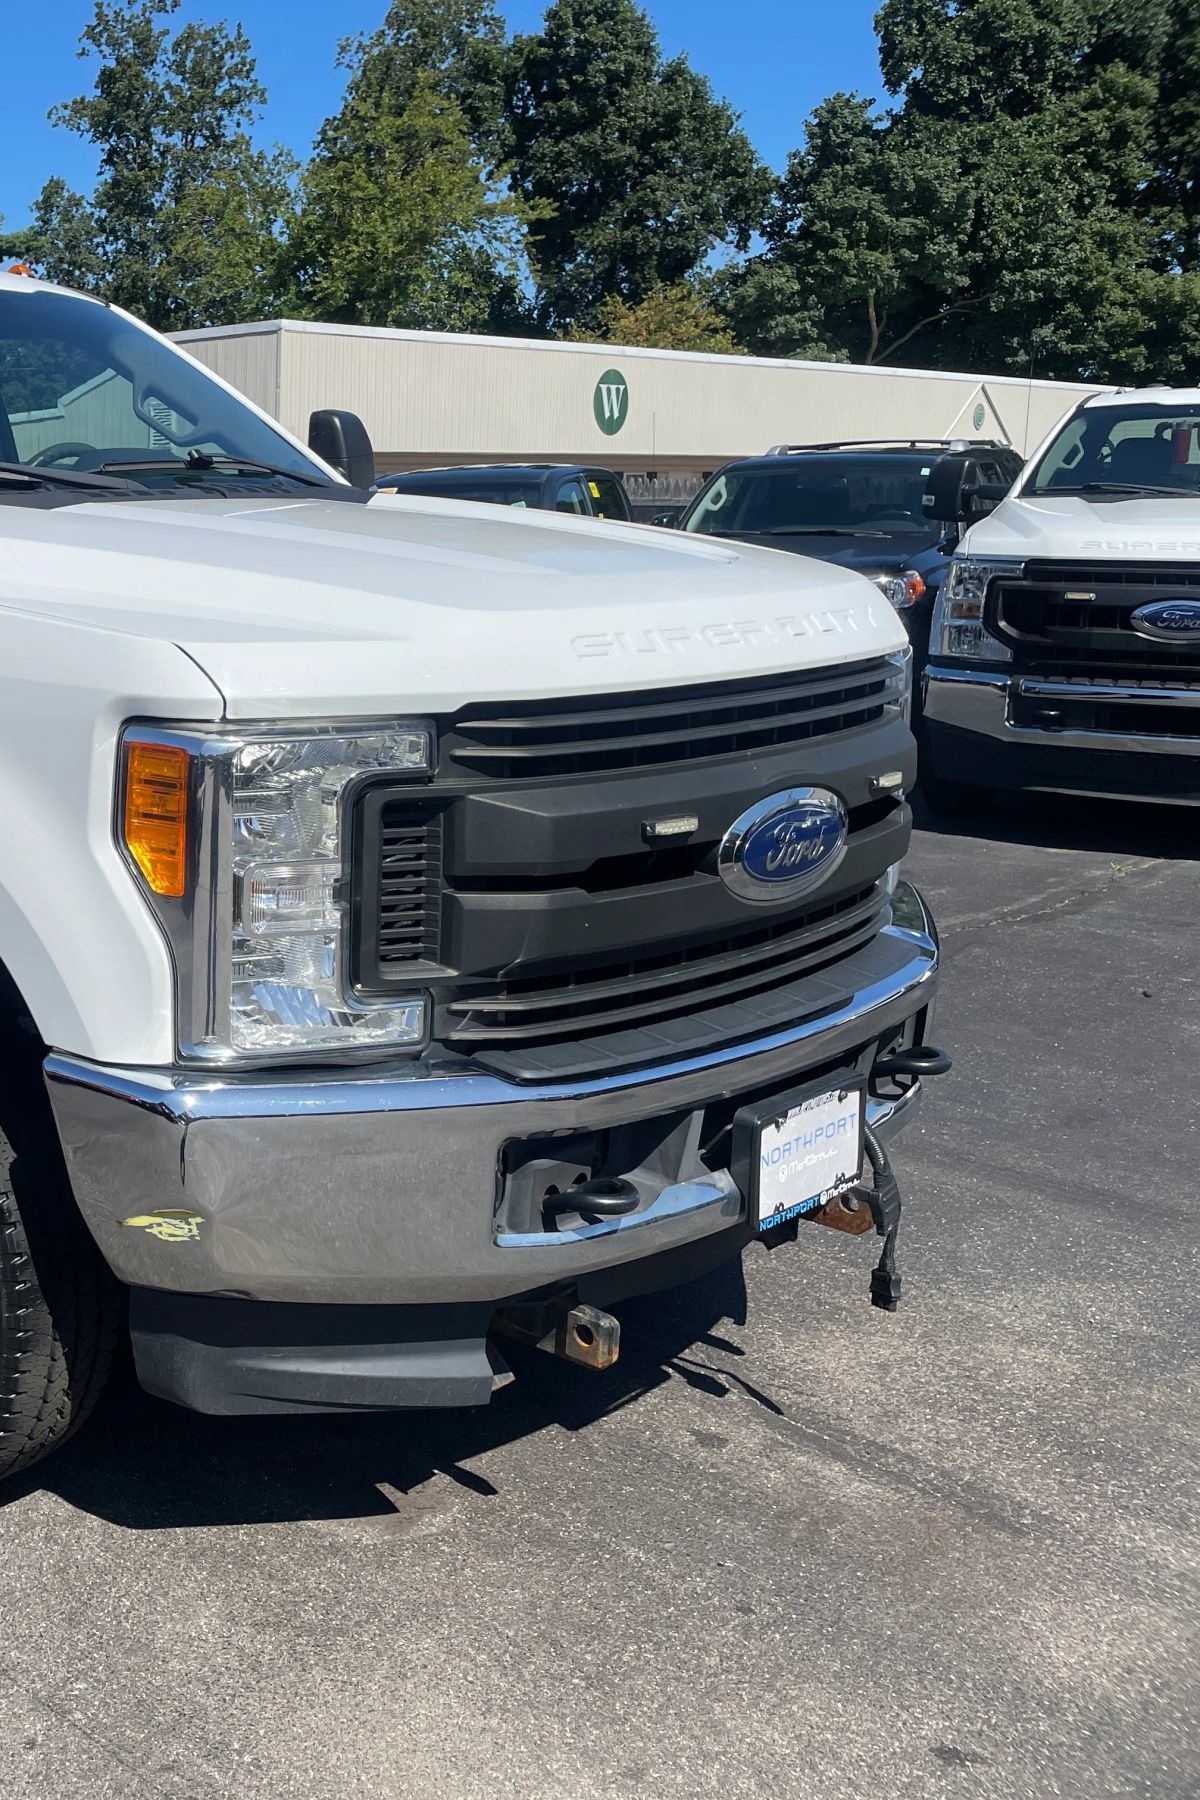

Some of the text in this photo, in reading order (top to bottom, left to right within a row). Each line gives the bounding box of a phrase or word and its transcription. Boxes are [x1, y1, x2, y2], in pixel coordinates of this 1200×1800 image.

[599, 383, 626, 420] W
[569, 603, 878, 661] SUPER DUTY
[765, 821, 826, 872] Ford
[761, 1113, 857, 1169] NORTHPORT
[760, 1196, 820, 1232] NORTHPORT
